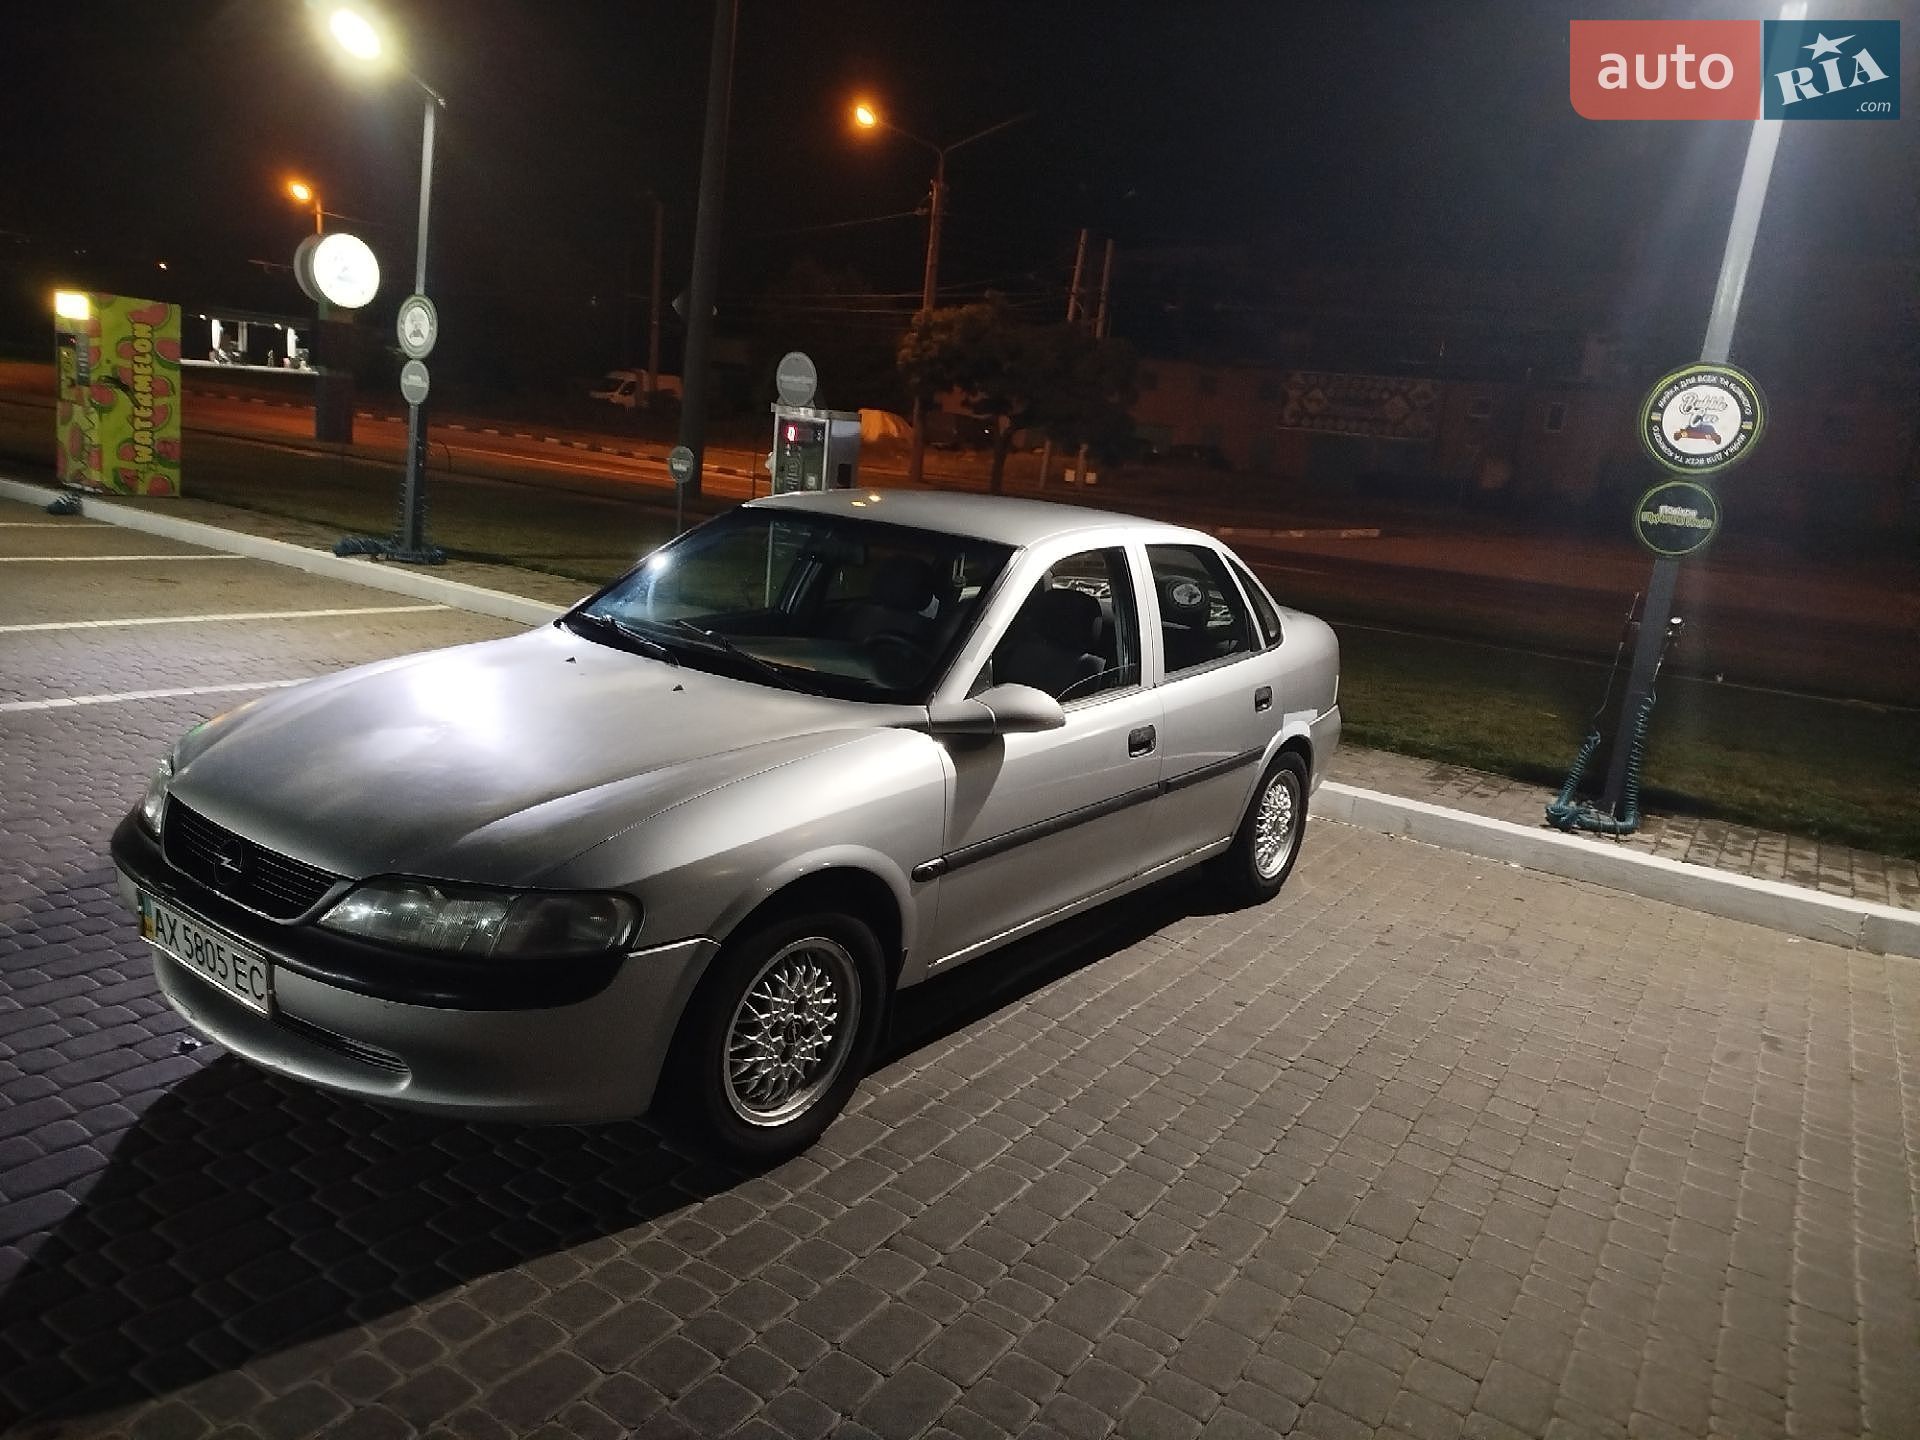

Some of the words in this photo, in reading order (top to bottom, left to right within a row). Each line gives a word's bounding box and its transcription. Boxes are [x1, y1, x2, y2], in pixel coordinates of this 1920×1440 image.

[133, 322, 153, 464] WATERMELON
[155, 908, 179, 951] AX
[183, 925, 228, 980] 5805
[232, 953, 265, 1000] EC
